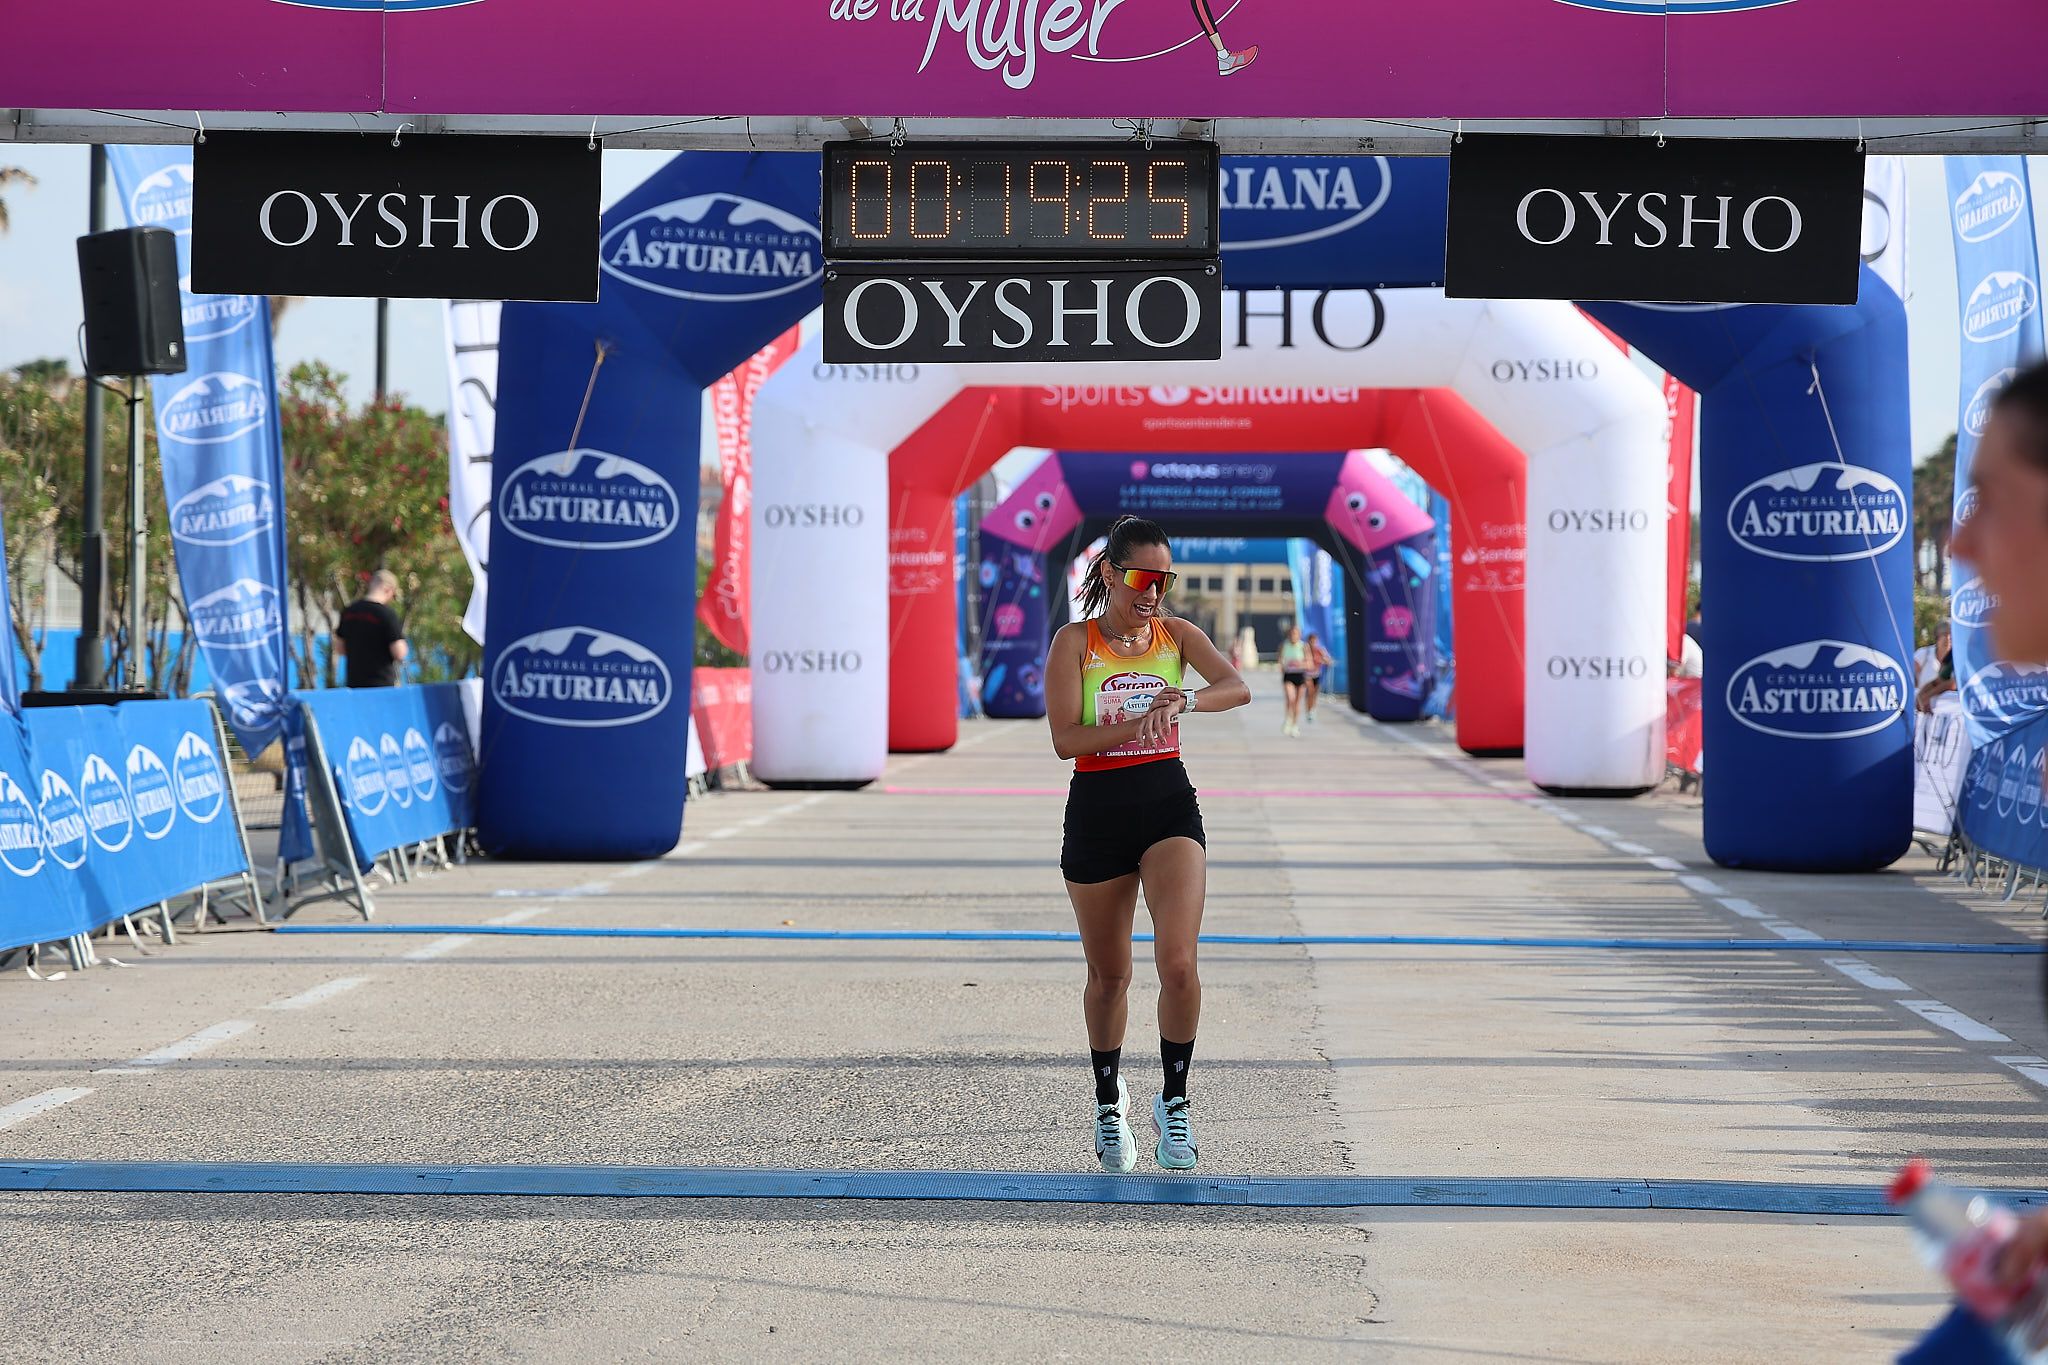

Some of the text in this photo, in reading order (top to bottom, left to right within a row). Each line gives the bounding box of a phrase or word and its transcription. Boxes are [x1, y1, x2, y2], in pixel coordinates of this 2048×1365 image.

[917, 0, 1126, 89] Mujer
[852, 161, 1189, 239] 00:19:25
[259, 190, 539, 251] OYSHO
[1516, 188, 1802, 252] OYSHO
[650, 225, 813, 248] CENTRAL LECHERA
[609, 228, 814, 277] ASTURIANA
[843, 276, 1201, 350] OYSHO
[813, 363, 920, 384] OYSHO
[1491, 359, 1598, 383] OYSHO
[1041, 384, 1360, 412] Sports Santander
[508, 483, 669, 529] ASTURIANA
[1768, 495, 1835, 508] CENTRAL
[764, 504, 864, 528] OYSHO
[1548, 509, 1648, 533] OYSHO
[1739, 499, 1901, 536] ASTURIANA
[763, 650, 863, 675] OYSHO
[1547, 655, 1648, 680] OYSHO
[501, 660, 661, 705] ASTURIANA
[1110, 679, 1164, 690] Serrano
[1766, 670, 1896, 685] CENTRAL LECHERA
[1738, 676, 1899, 714] ASTURIANA
